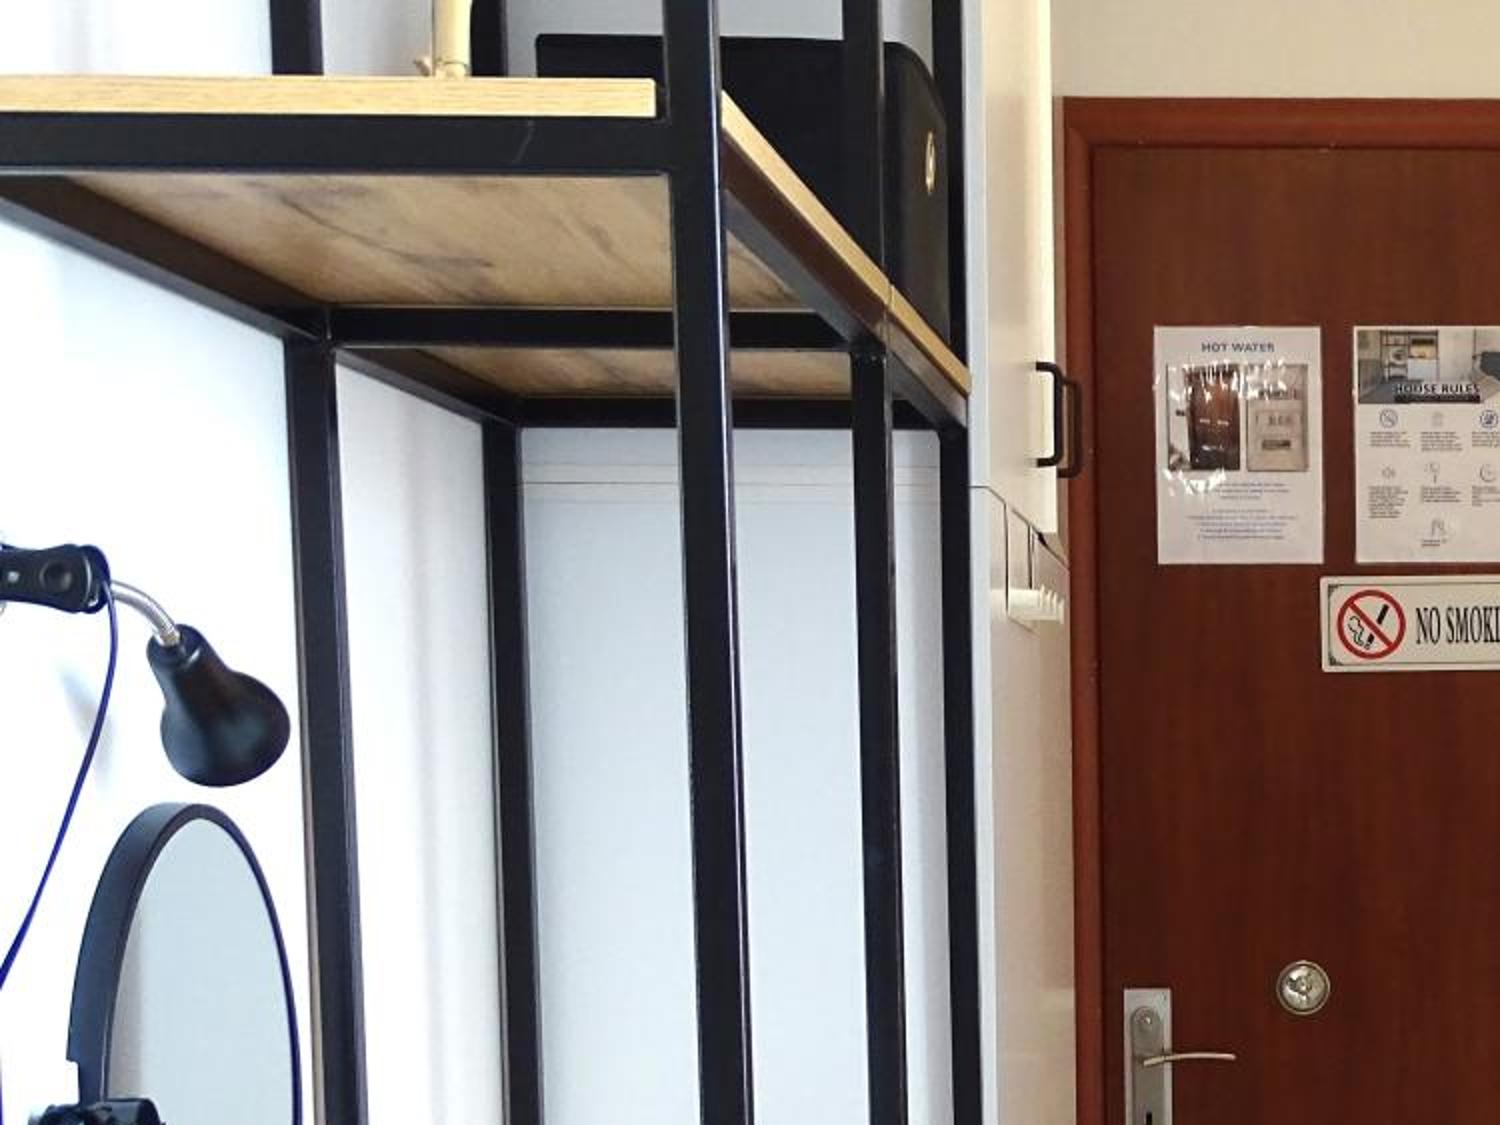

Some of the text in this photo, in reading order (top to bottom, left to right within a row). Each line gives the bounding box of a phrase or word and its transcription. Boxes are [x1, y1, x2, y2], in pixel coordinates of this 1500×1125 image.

[1201, 342, 1275, 353] HOT WATER
[1395, 383, 1480, 394] HOUSE RULES
[1416, 606, 1441, 645] NO
